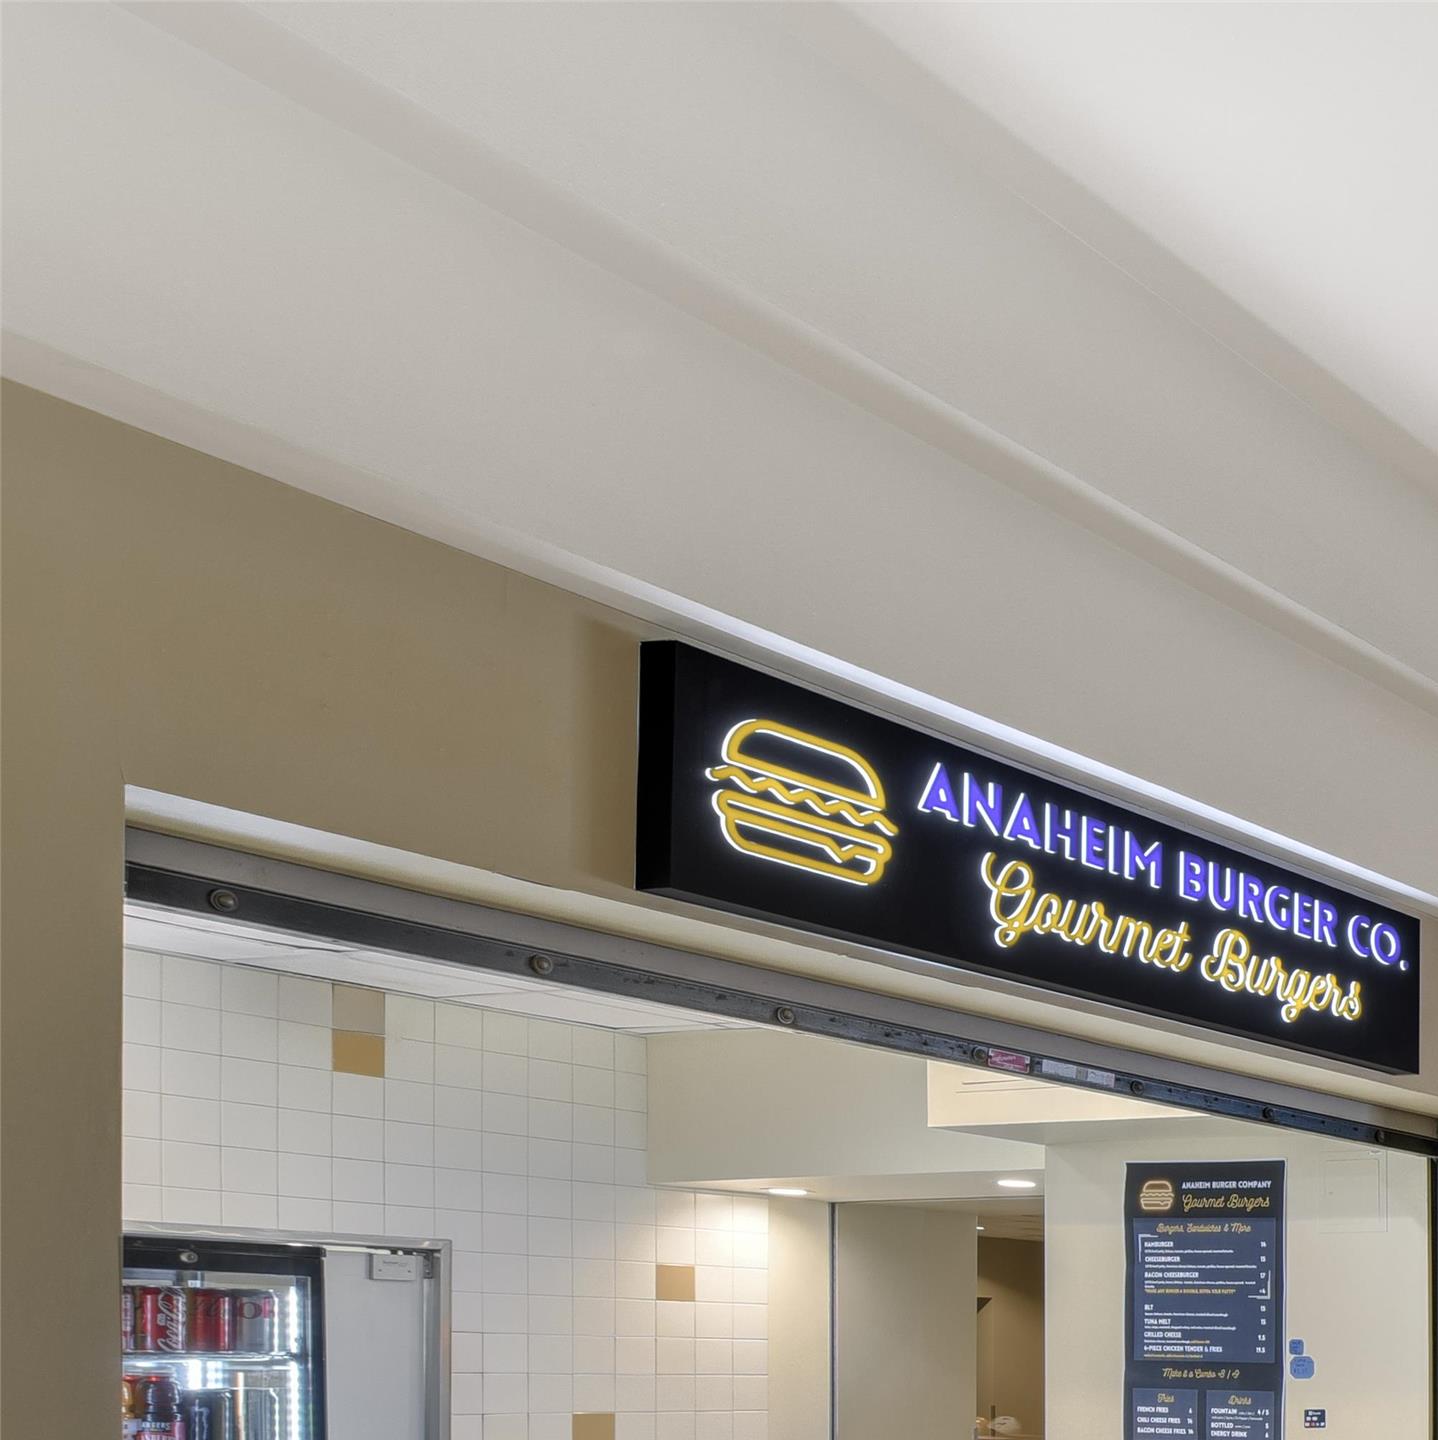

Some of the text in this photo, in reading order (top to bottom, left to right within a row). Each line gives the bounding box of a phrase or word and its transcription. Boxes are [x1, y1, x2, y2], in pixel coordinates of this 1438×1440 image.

[917, 762, 1410, 971] ANAHEIM BURGER CO.
[980, 851, 1364, 1023] Gourmet Burgers
[1182, 1180, 1272, 1189] ANAHEIM BURGER COMPANY
[1182, 1194, 1270, 1212] Gourmet Burgers
[1211, 1421, 1234, 1429] BOTTLED
